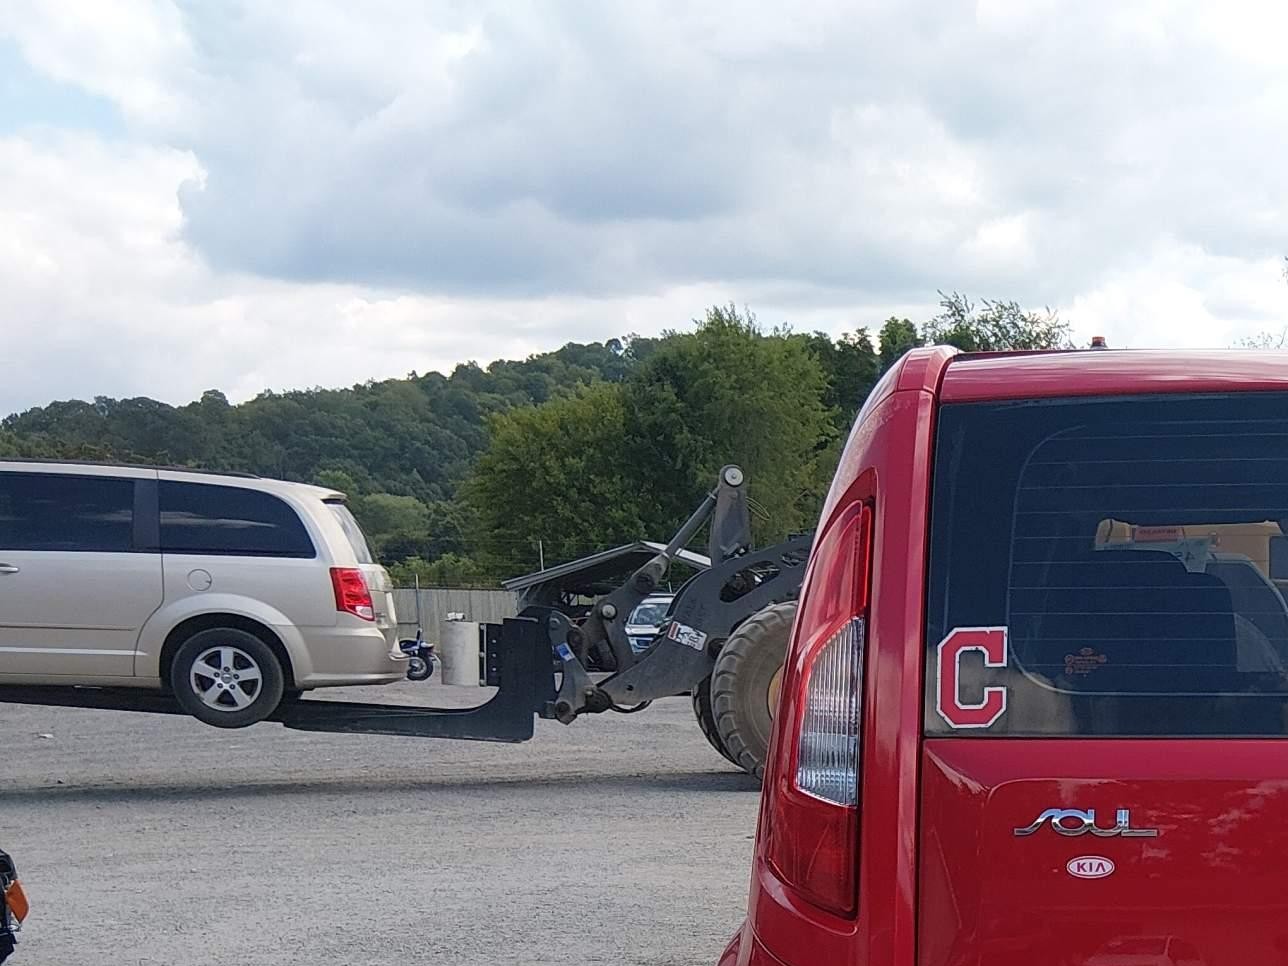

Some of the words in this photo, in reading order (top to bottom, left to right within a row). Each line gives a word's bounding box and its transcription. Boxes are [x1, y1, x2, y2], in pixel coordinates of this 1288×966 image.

[936, 626, 1008, 729] C
[1014, 808, 1158, 837] SOUL
[1076, 862, 1106, 873] KIA
